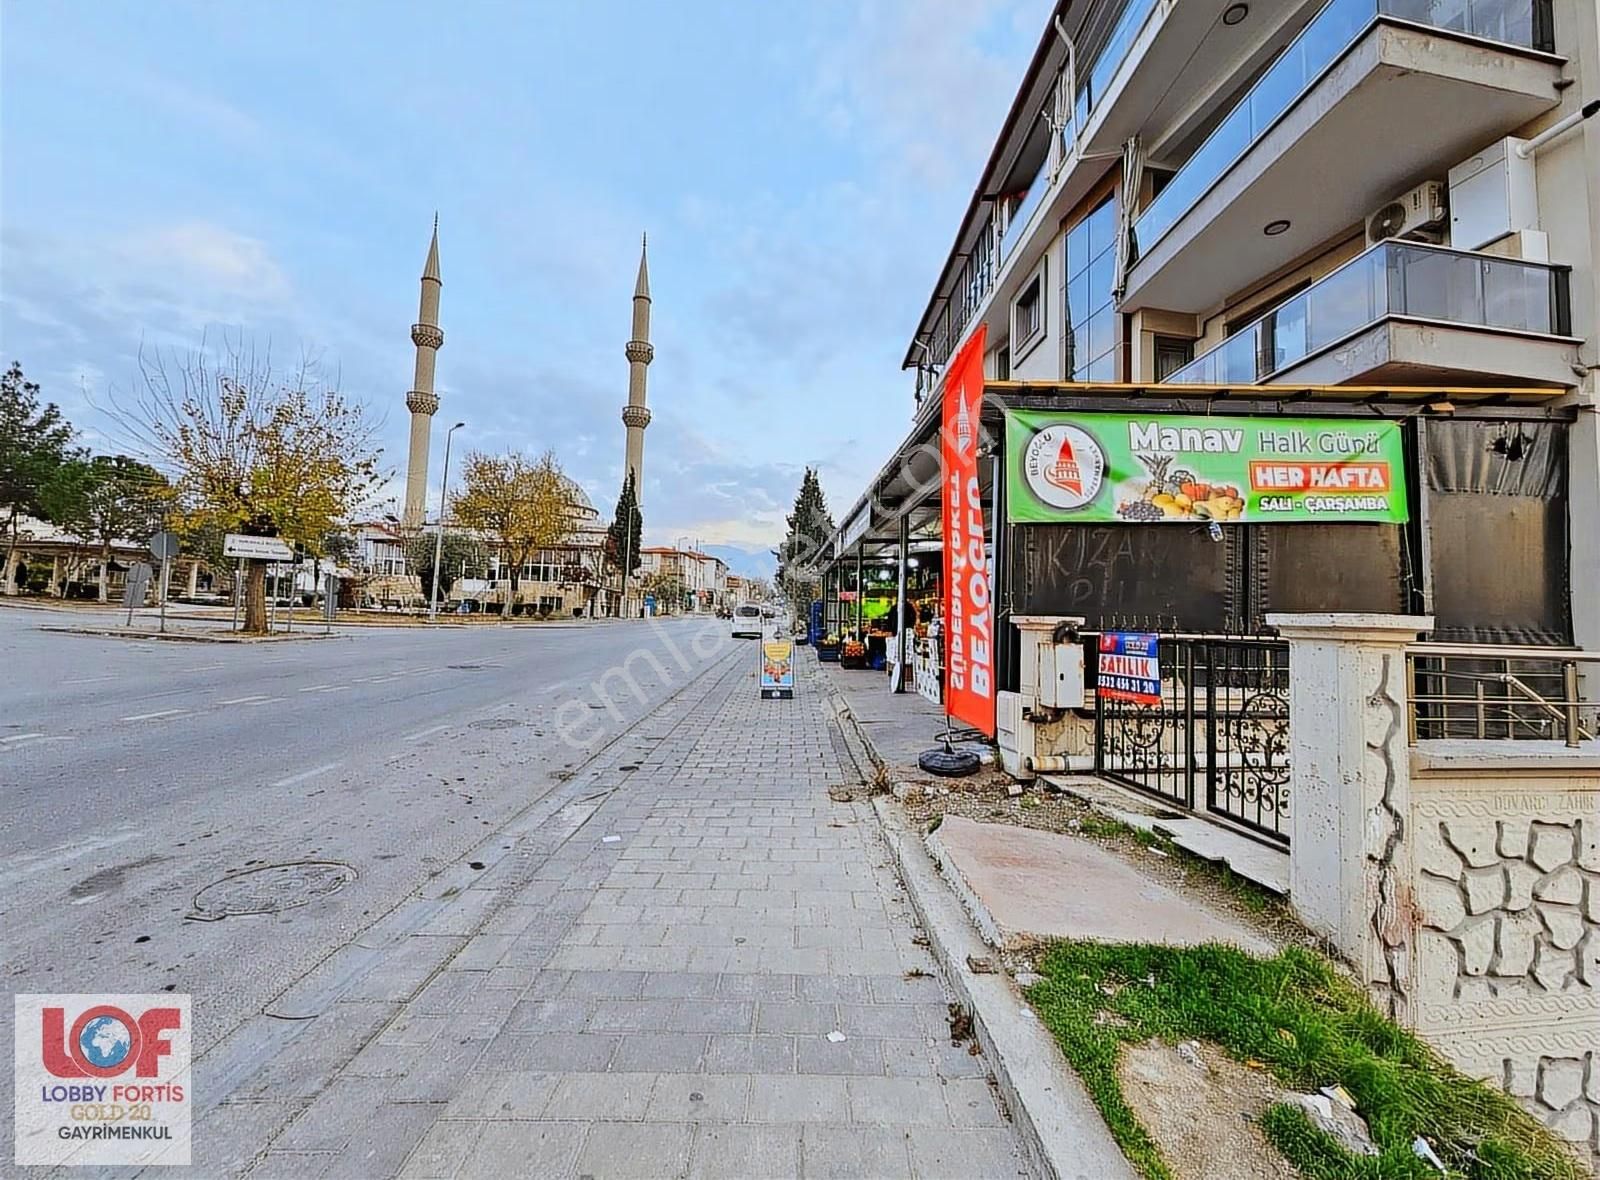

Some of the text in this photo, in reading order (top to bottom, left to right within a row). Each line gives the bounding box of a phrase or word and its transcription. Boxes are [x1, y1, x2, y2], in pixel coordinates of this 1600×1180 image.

[1128, 421, 1243, 453] Manav
[1258, 431, 1380, 453] Halk Günü
[1255, 466, 1386, 488] HER HAFTA
[1259, 496, 1293, 511] SALI
[1305, 496, 1389, 514] ÇARŞAMBA
[1100, 655, 1151, 678] SATILIK
